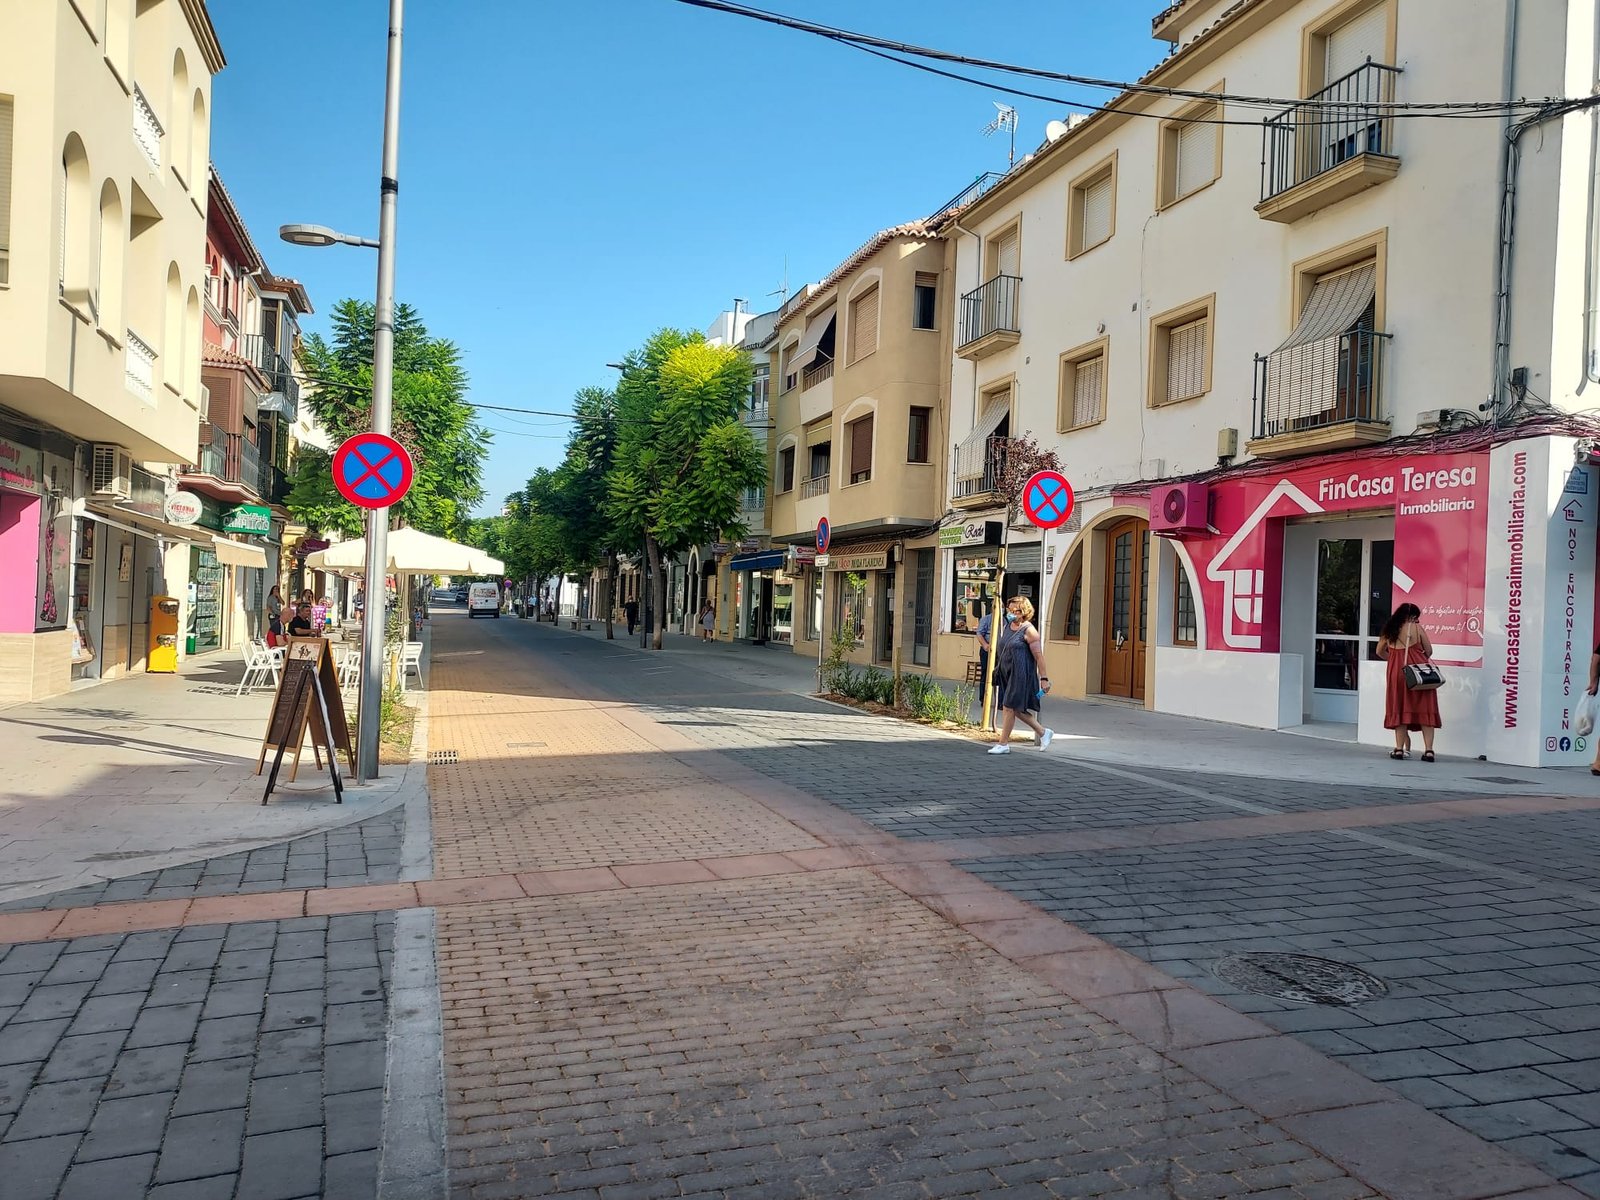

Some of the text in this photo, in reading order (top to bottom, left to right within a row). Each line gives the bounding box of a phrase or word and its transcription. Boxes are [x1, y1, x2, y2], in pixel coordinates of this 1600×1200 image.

[1318, 466, 1477, 502] FinCasa Teresa
[1400, 496, 1475, 516] Inmobiliaria
[1568, 528, 1577, 561] NOS
[1502, 451, 1527, 729] www.fincasateresainmobiliaria.com
[1561, 708, 1569, 730] EN
